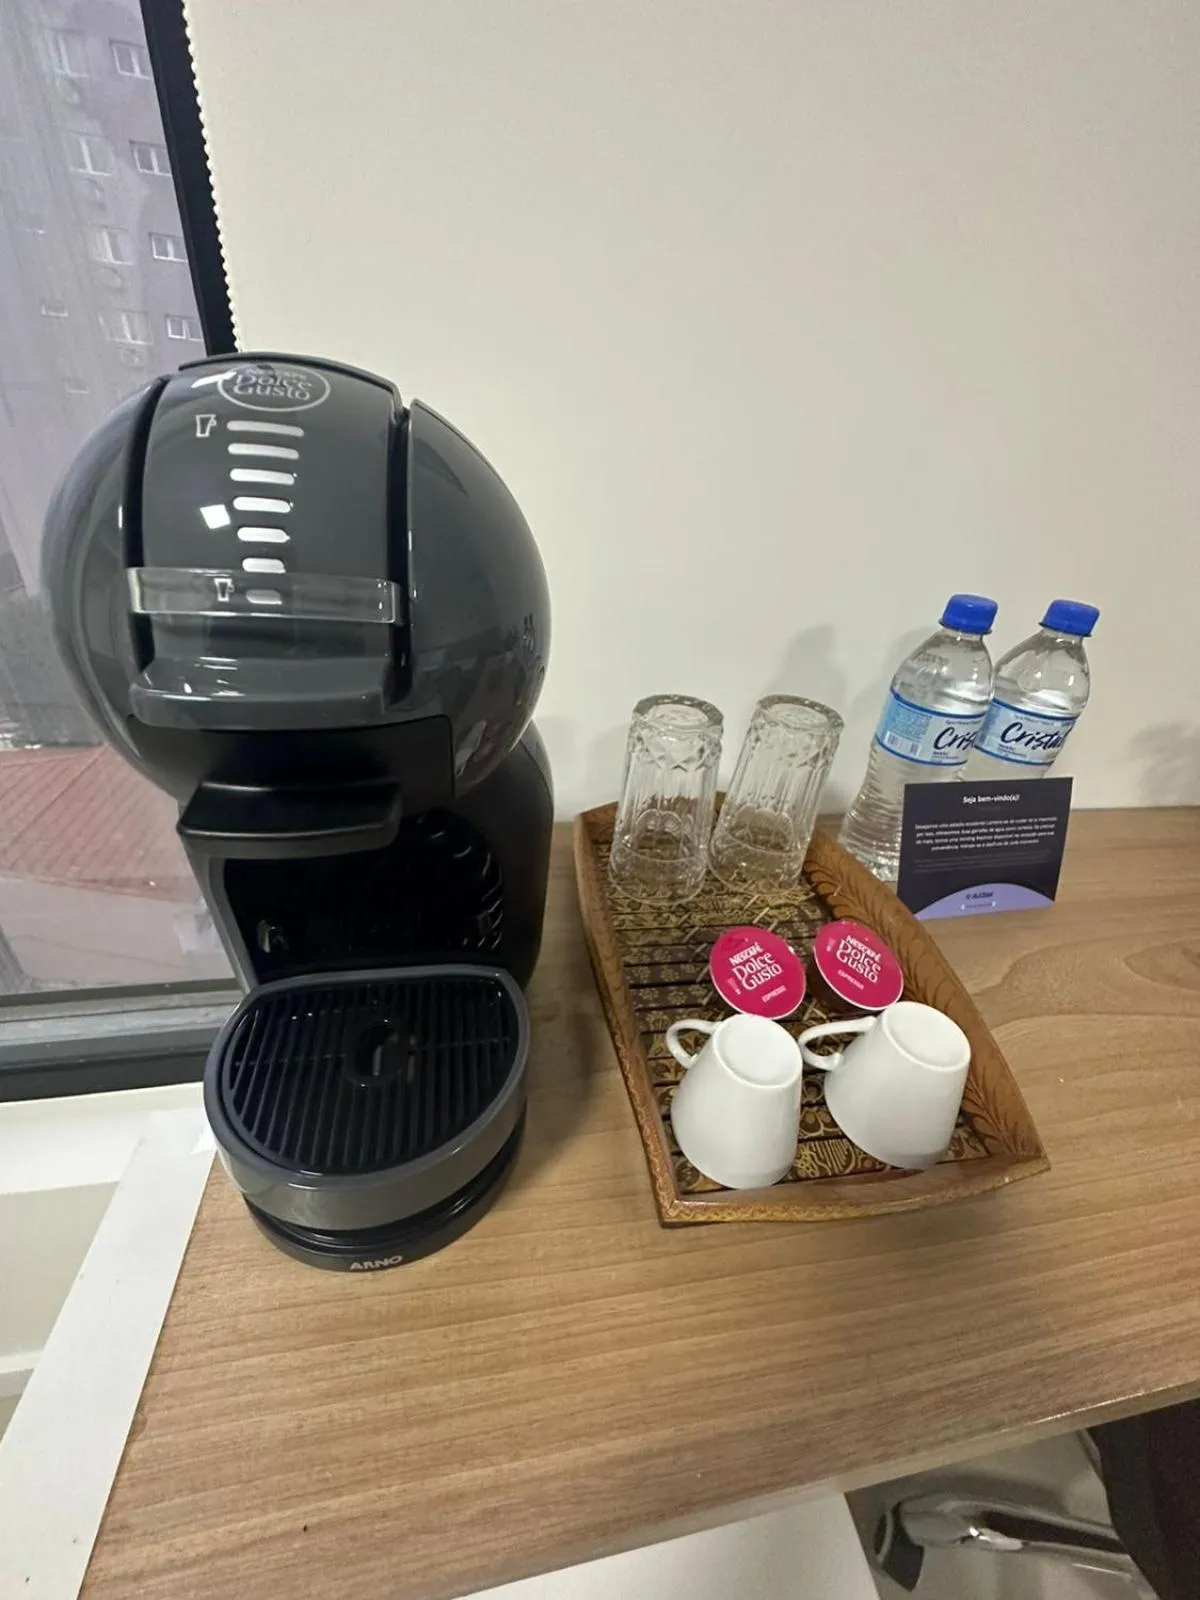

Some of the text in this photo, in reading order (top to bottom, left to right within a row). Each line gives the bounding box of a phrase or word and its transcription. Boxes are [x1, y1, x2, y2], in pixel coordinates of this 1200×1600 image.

[232, 384, 310, 401] Gusto
[933, 726, 978, 751] Cris
[963, 795, 977, 805] Seja
[732, 952, 776, 982] Dolce
[836, 949, 878, 984] Gusto
[838, 939, 882, 975] Dolce
[741, 963, 783, 991] Gusto
[350, 1255, 403, 1270] ARNO
